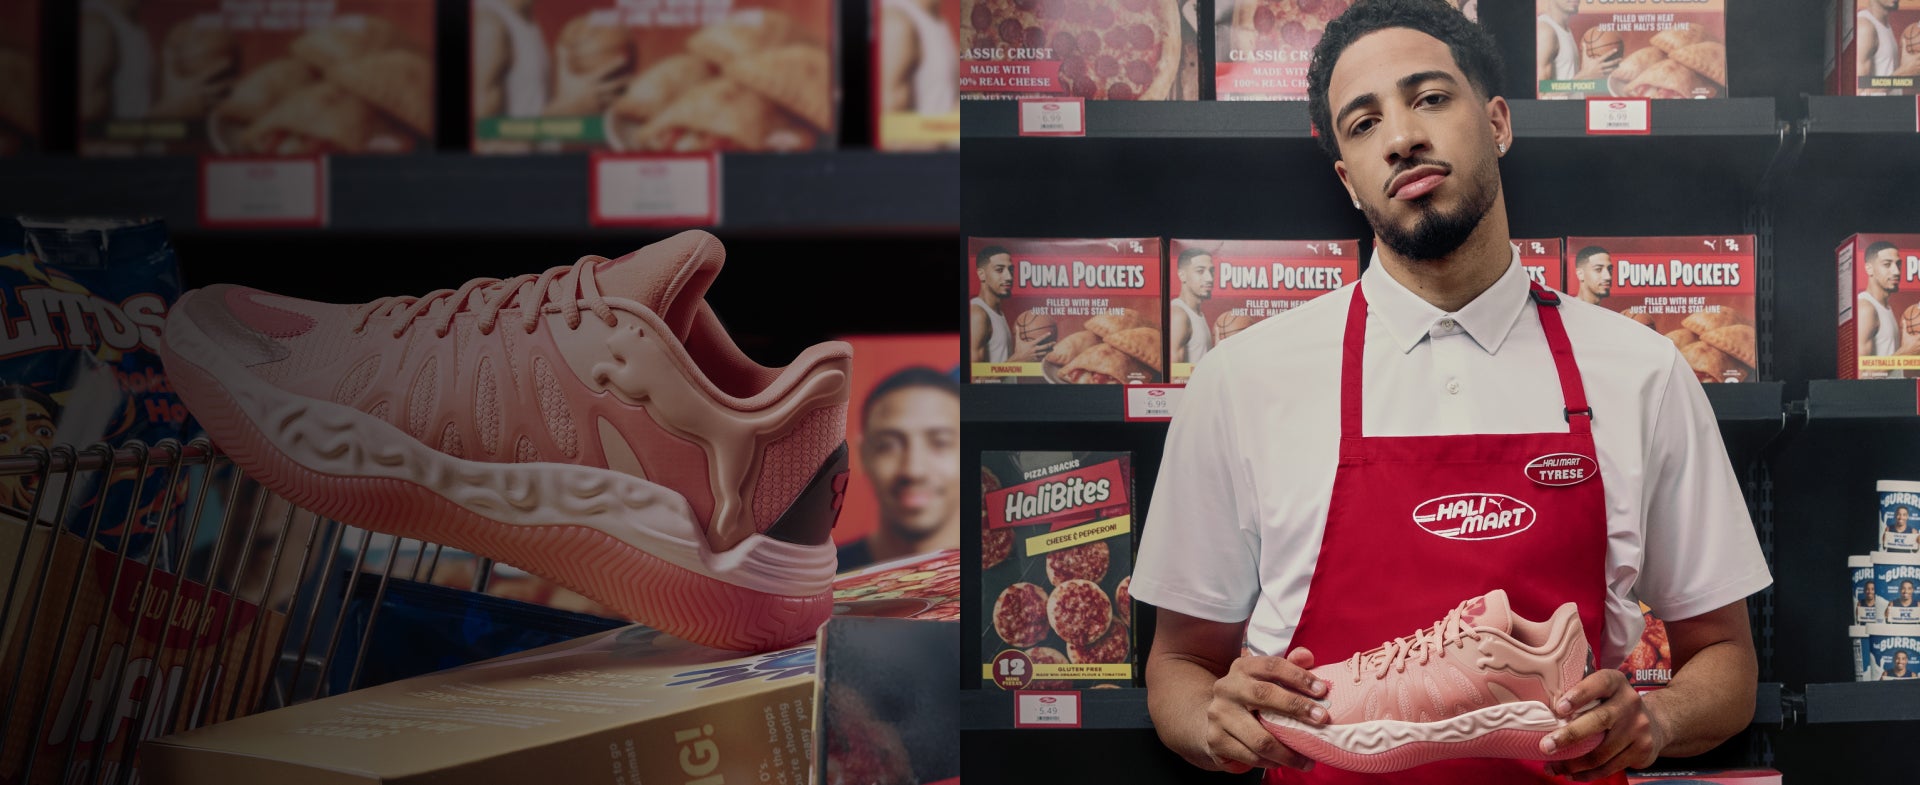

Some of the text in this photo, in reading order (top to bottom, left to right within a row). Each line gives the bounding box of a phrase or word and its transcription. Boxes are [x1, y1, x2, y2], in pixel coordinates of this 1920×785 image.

[1612, 14, 1674, 22] FILLED WITH HEAT
[1598, 23, 1615, 31] JUST
[1617, 23, 1632, 31] LIKE
[1657, 23, 1672, 31] STAT
[1674, 23, 1689, 31] LINE
[1007, 47, 1053, 59] CRUST
[1229, 49, 1286, 61] CLASSIC
[970, 65, 1031, 75] MADE WITH
[1252, 67, 1283, 76] MADE
[979, 77, 1006, 87] REAL
[1009, 77, 1051, 87] CHEESE
[1261, 80, 1288, 88] REAL
[1573, 82, 1595, 90] POCKET
[1019, 260, 1145, 288] PUMA POCKETS
[1220, 262, 1343, 289] PUMA POCKETS
[1617, 259, 1741, 286] PUMA POCKETS
[1046, 299, 1070, 307] FILLED
[1072, 299, 1090, 307] WITH
[1246, 300, 1269, 308] FILLED
[1271, 300, 1289, 308] WITH
[1644, 297, 1705, 305] FILLED WITH HEAT
[1031, 307, 1125, 316] JUST LIKE HALI'S STAT LINE
[1231, 308, 1248, 316] JUST
[1250, 308, 1265, 317] LIKE
[1630, 305, 1721, 314] JUST LIKE HALI'S STAT LINE
[1543, 457, 1581, 467] HALI MART
[1024, 459, 1080, 481] PIZZA SNACKS
[1539, 468, 1584, 480] TYRESE
[1005, 477, 1111, 522] HaliBites
[1436, 496, 1487, 522] HALI
[1459, 507, 1526, 535] MART
[1046, 534, 1072, 546] CHEESE
[1079, 523, 1117, 539] PEPPERONI
[998, 658, 1026, 676] 12
[794, 699, 808, 722] you
[1039, 707, 1058, 715] 5.49
[763, 705, 778, 744] hoops
[779, 703, 797, 754] shooting
[609, 742, 622, 759] go
[773, 747, 784, 767] the
